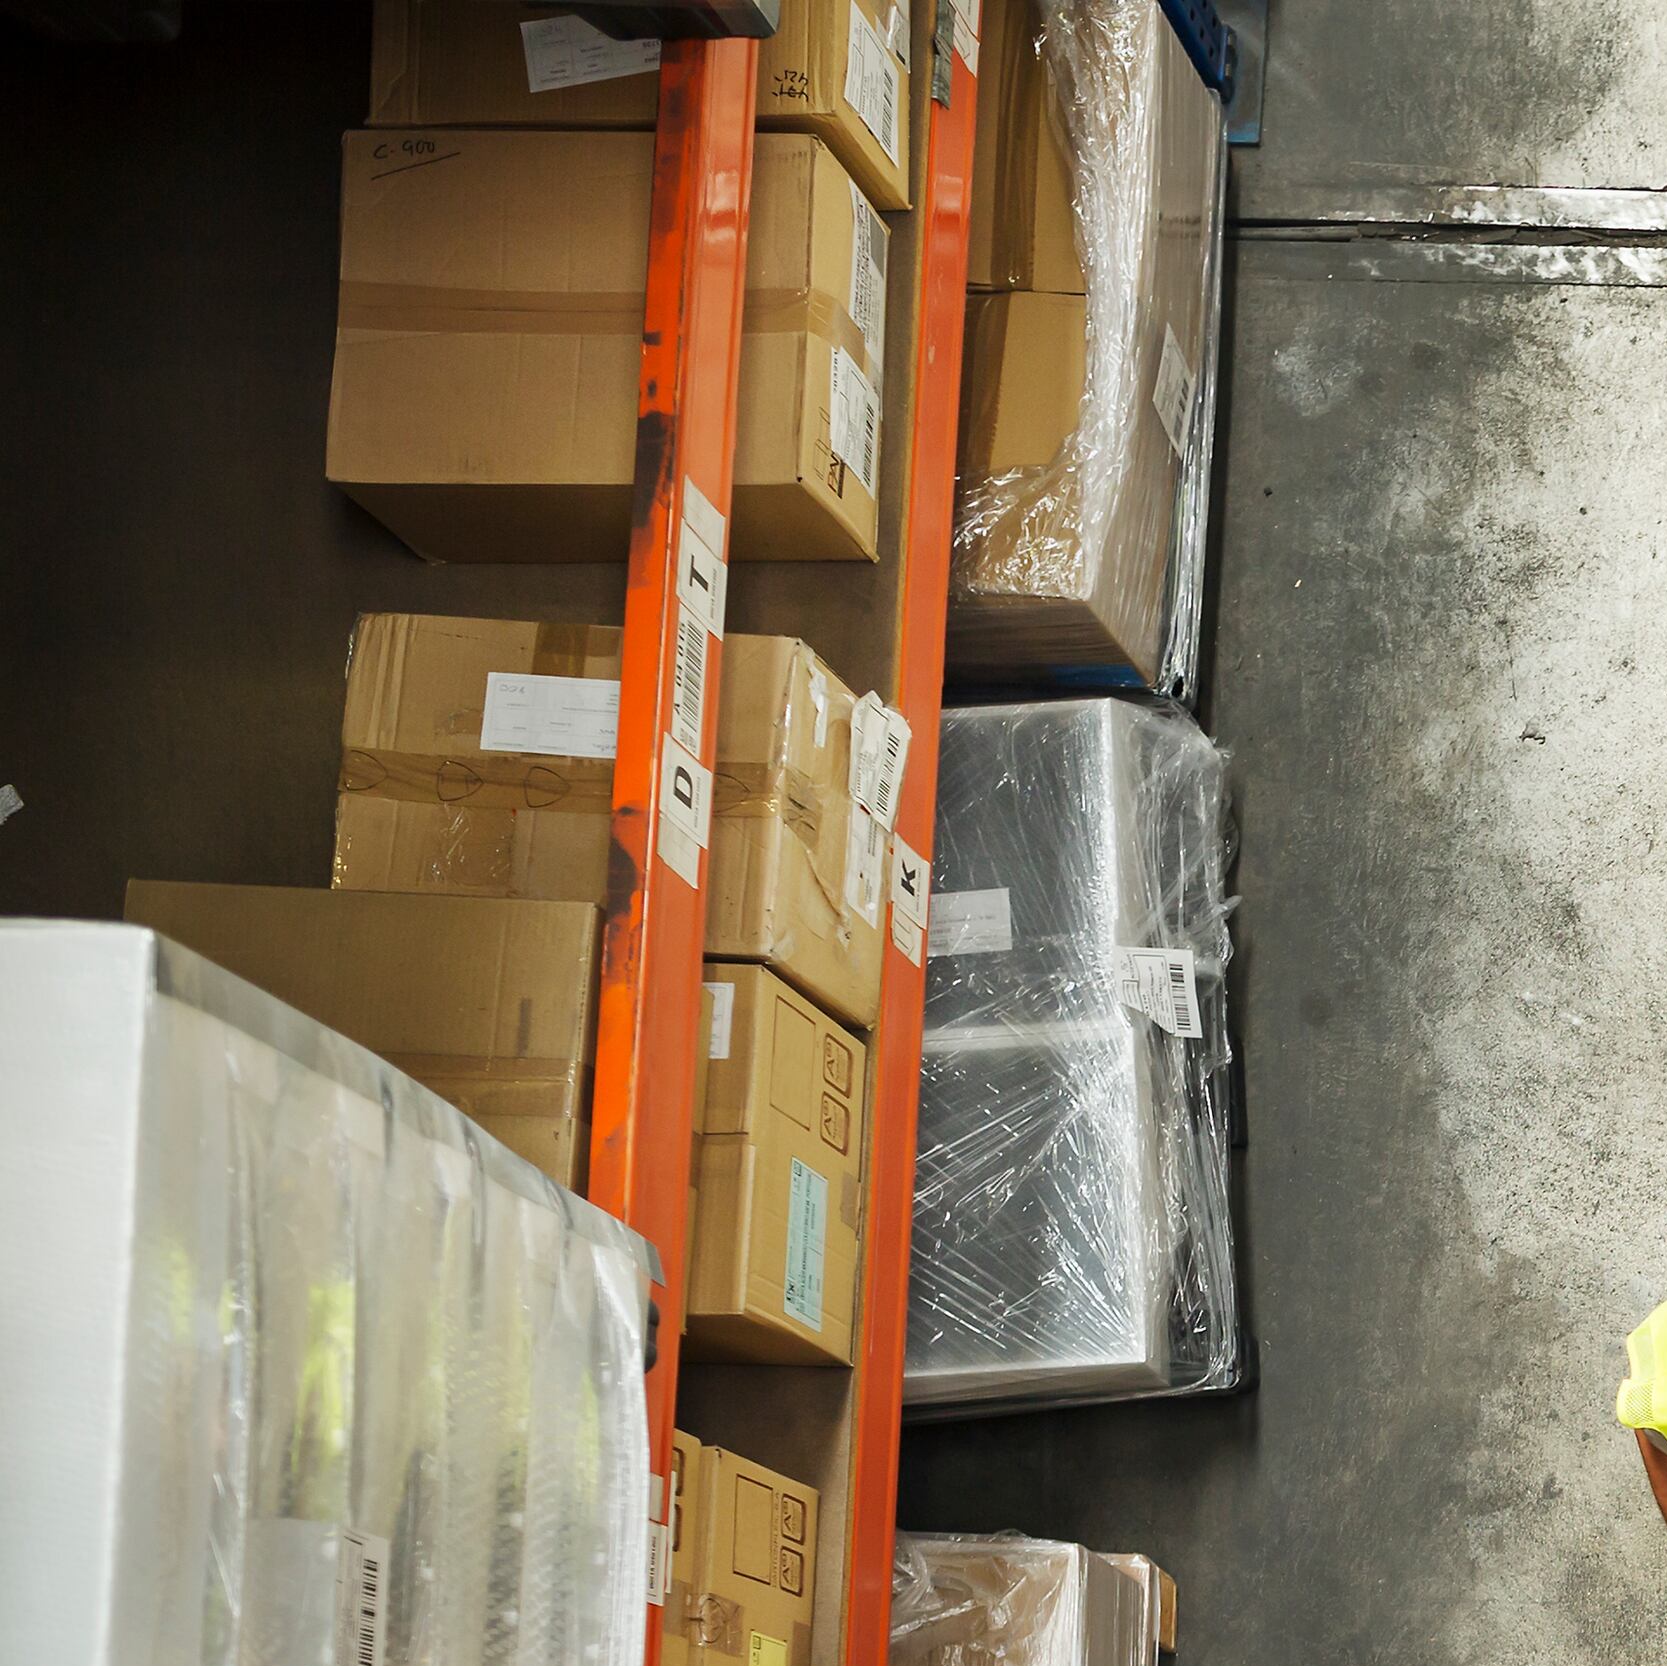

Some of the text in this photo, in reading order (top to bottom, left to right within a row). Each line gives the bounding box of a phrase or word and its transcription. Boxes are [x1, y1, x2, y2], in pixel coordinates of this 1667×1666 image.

[690, 555, 709, 593] T
[673, 765, 693, 810] D
[900, 859, 917, 897] K
